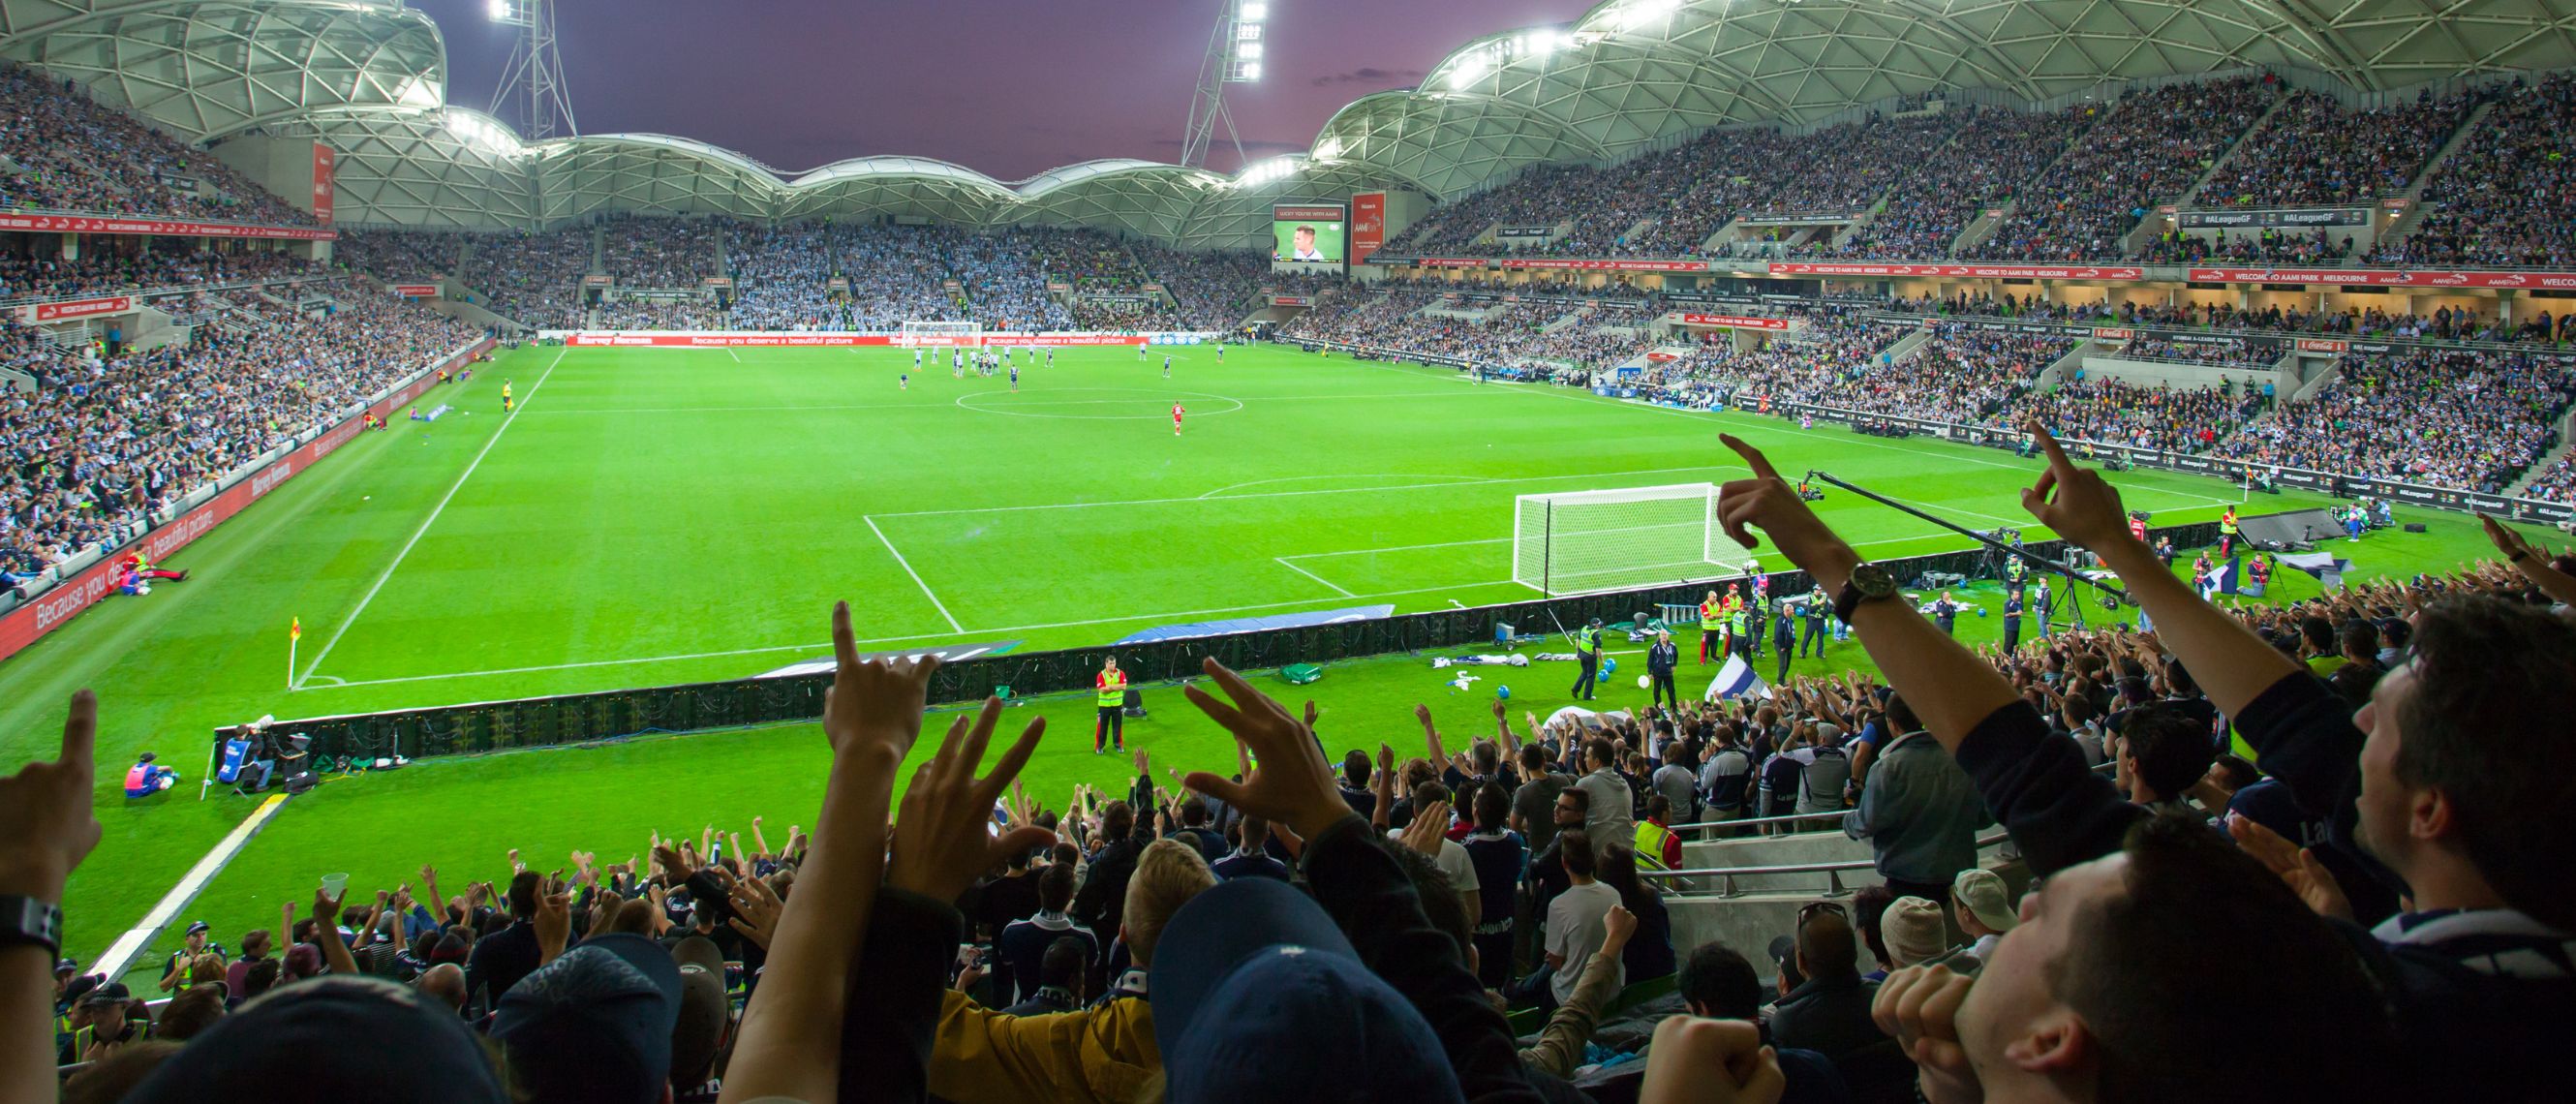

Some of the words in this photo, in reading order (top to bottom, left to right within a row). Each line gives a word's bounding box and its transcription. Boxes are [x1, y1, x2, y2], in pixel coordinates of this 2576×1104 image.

[2205, 215, 2252, 224] #ALeagueGF
[2284, 213, 2334, 223] #ALeagueGF
[825, 337, 853, 346] picture
[1068, 336, 1100, 345] beautiful
[1102, 337, 1125, 346] picture
[154, 519, 188, 558] beautiful
[189, 508, 214, 541] picture
[37, 585, 84, 629] Because
[85, 578, 106, 604] you
